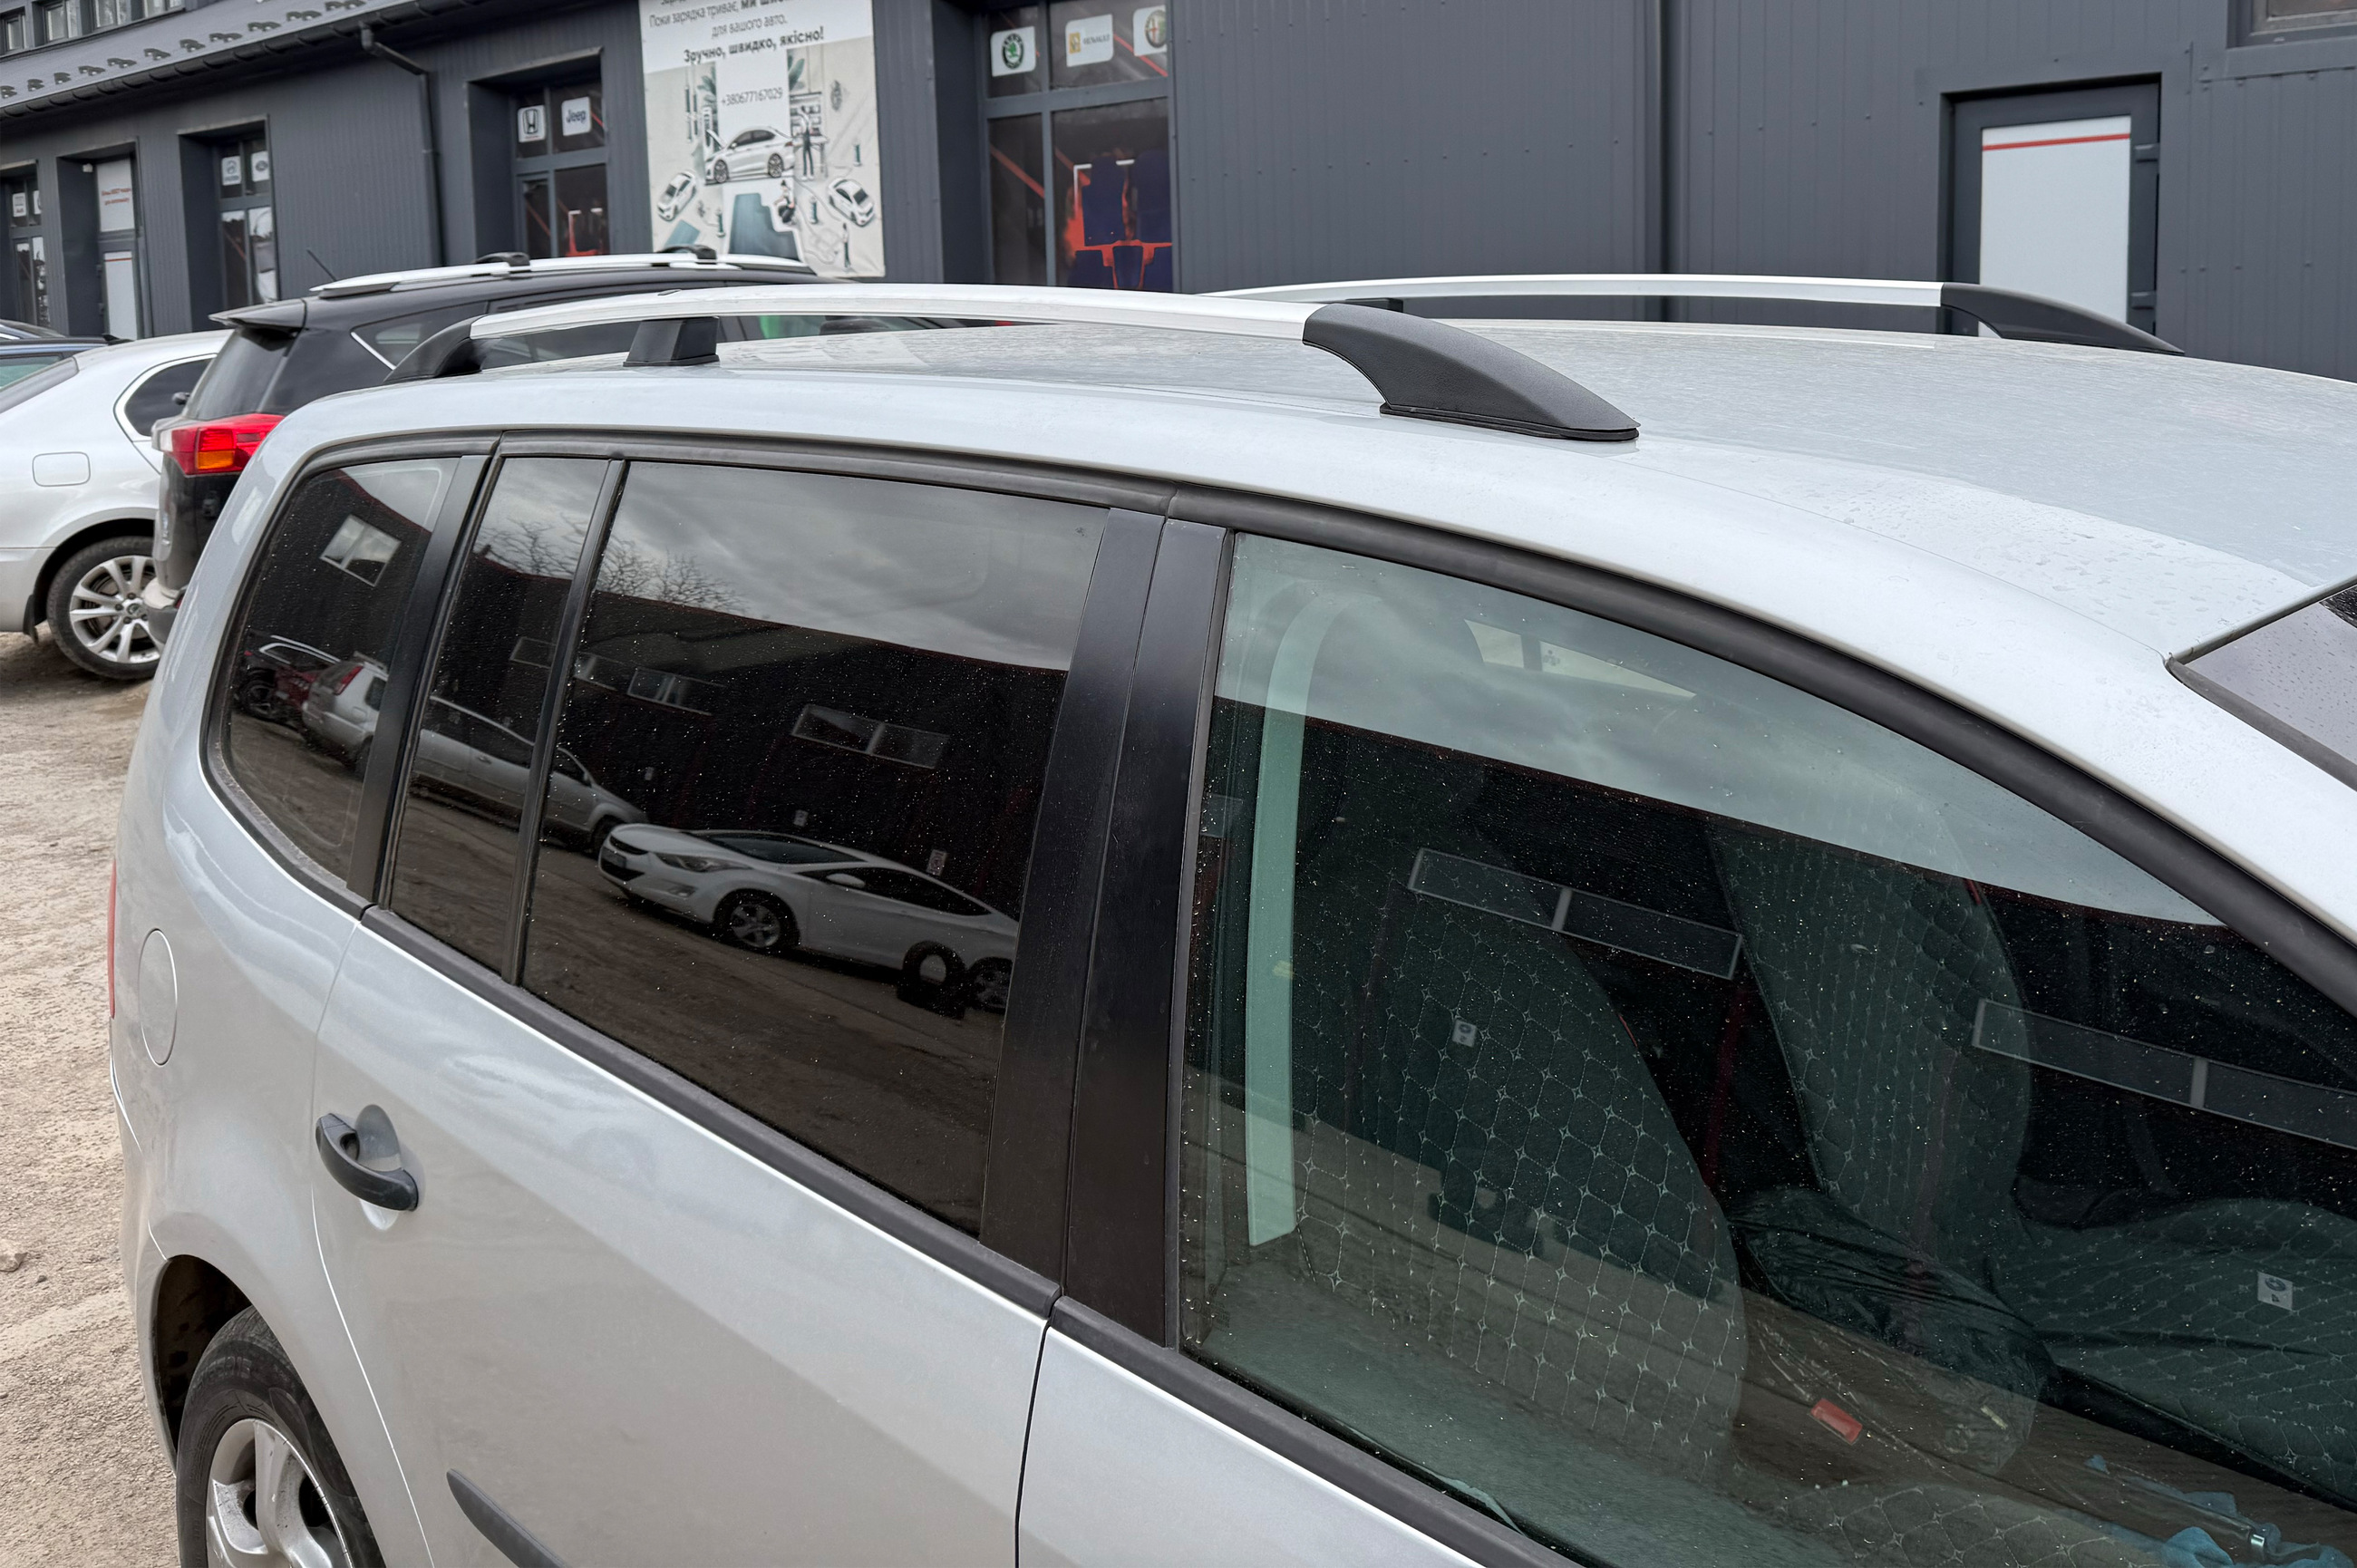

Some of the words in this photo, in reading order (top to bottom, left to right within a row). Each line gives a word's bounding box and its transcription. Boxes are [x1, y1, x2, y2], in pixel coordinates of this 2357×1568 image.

[649, 15, 671, 27] Поки
[672, 7, 705, 24] зарядка
[712, 24, 727, 39] для
[729, 18, 762, 34] вашого
[684, 46, 726, 65] Зручно,
[729, 38, 777, 53] швидко,
[780, 25, 824, 46] якісно!
[566, 110, 587, 124] Jeep
